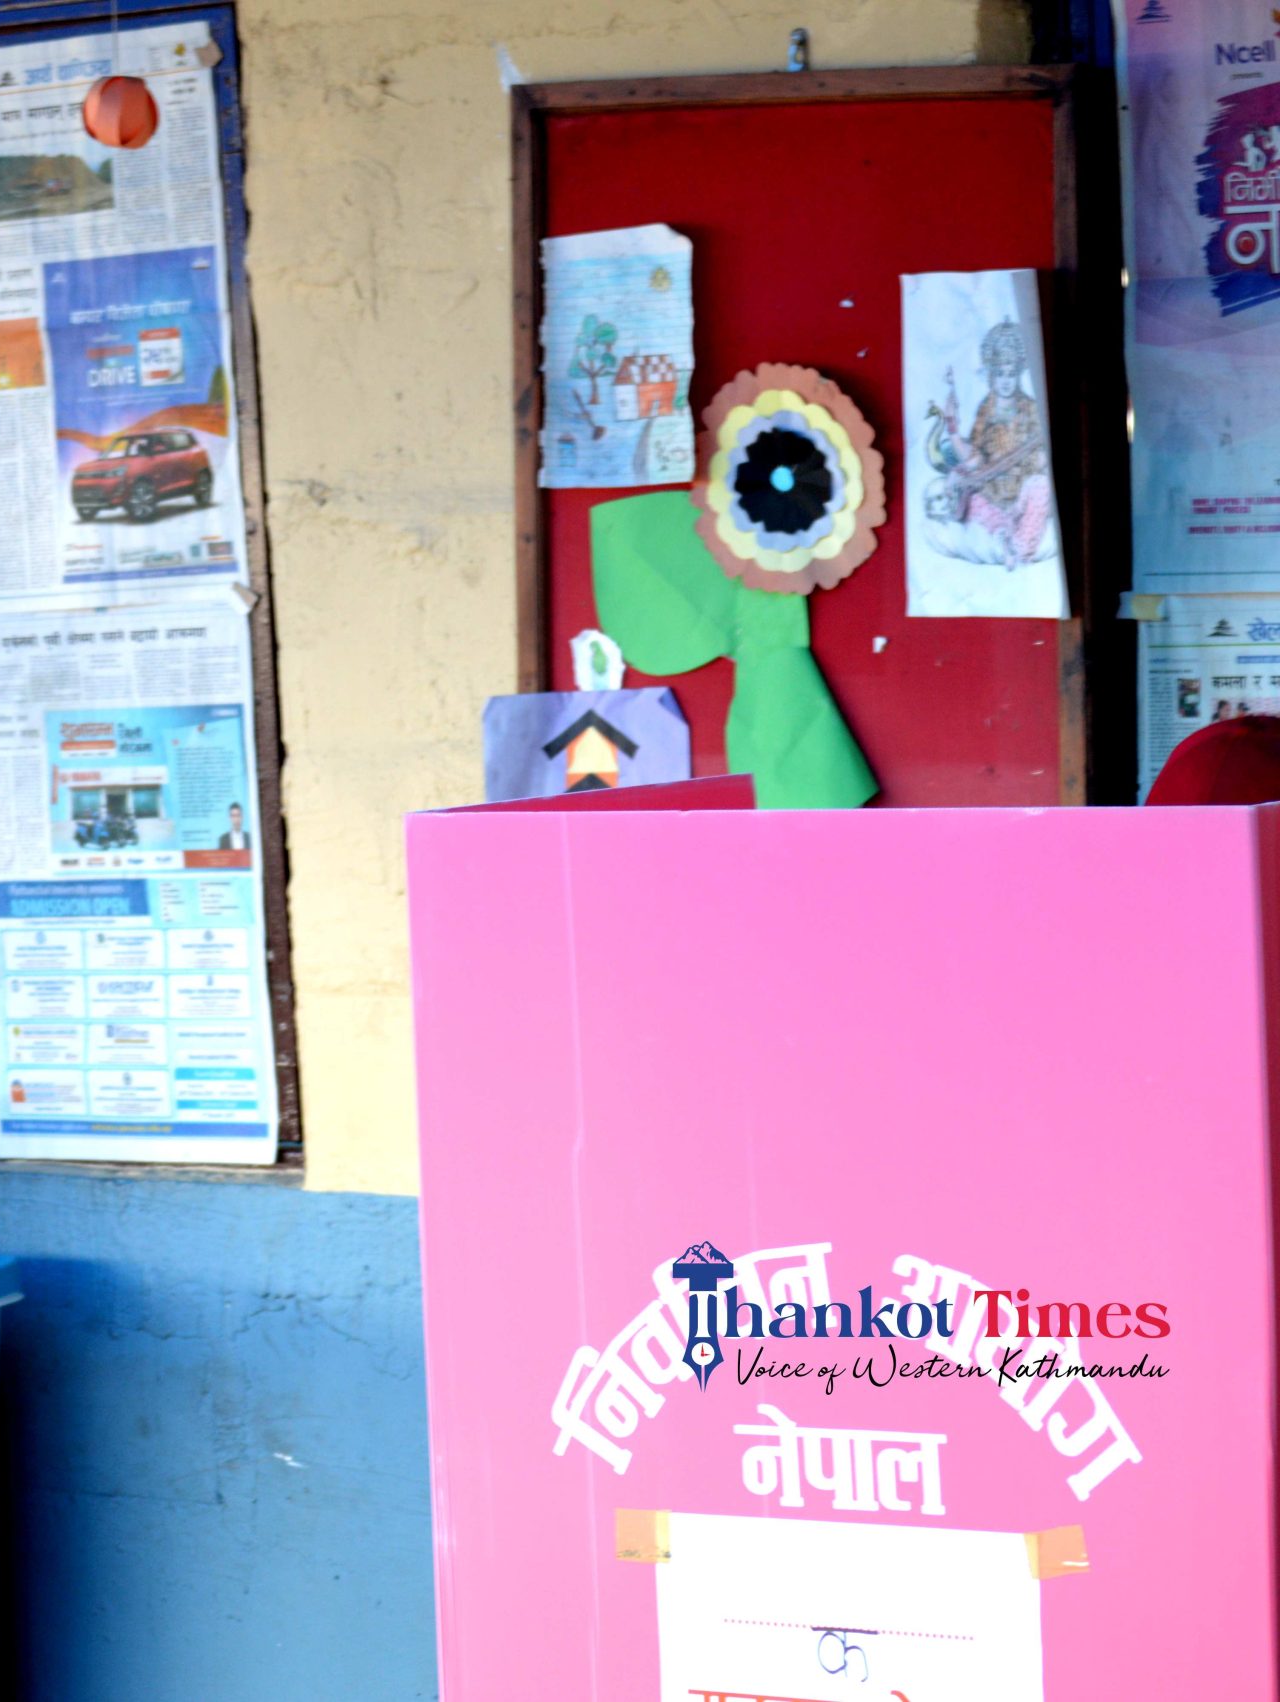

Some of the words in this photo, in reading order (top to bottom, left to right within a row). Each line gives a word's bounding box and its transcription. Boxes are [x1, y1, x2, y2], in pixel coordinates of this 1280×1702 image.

[1214, 39, 1276, 66] Ncell
[87, 364, 136, 388] DRIVE
[732, 1402, 948, 1516] नेपाल
[810, 1625, 879, 1683] क
